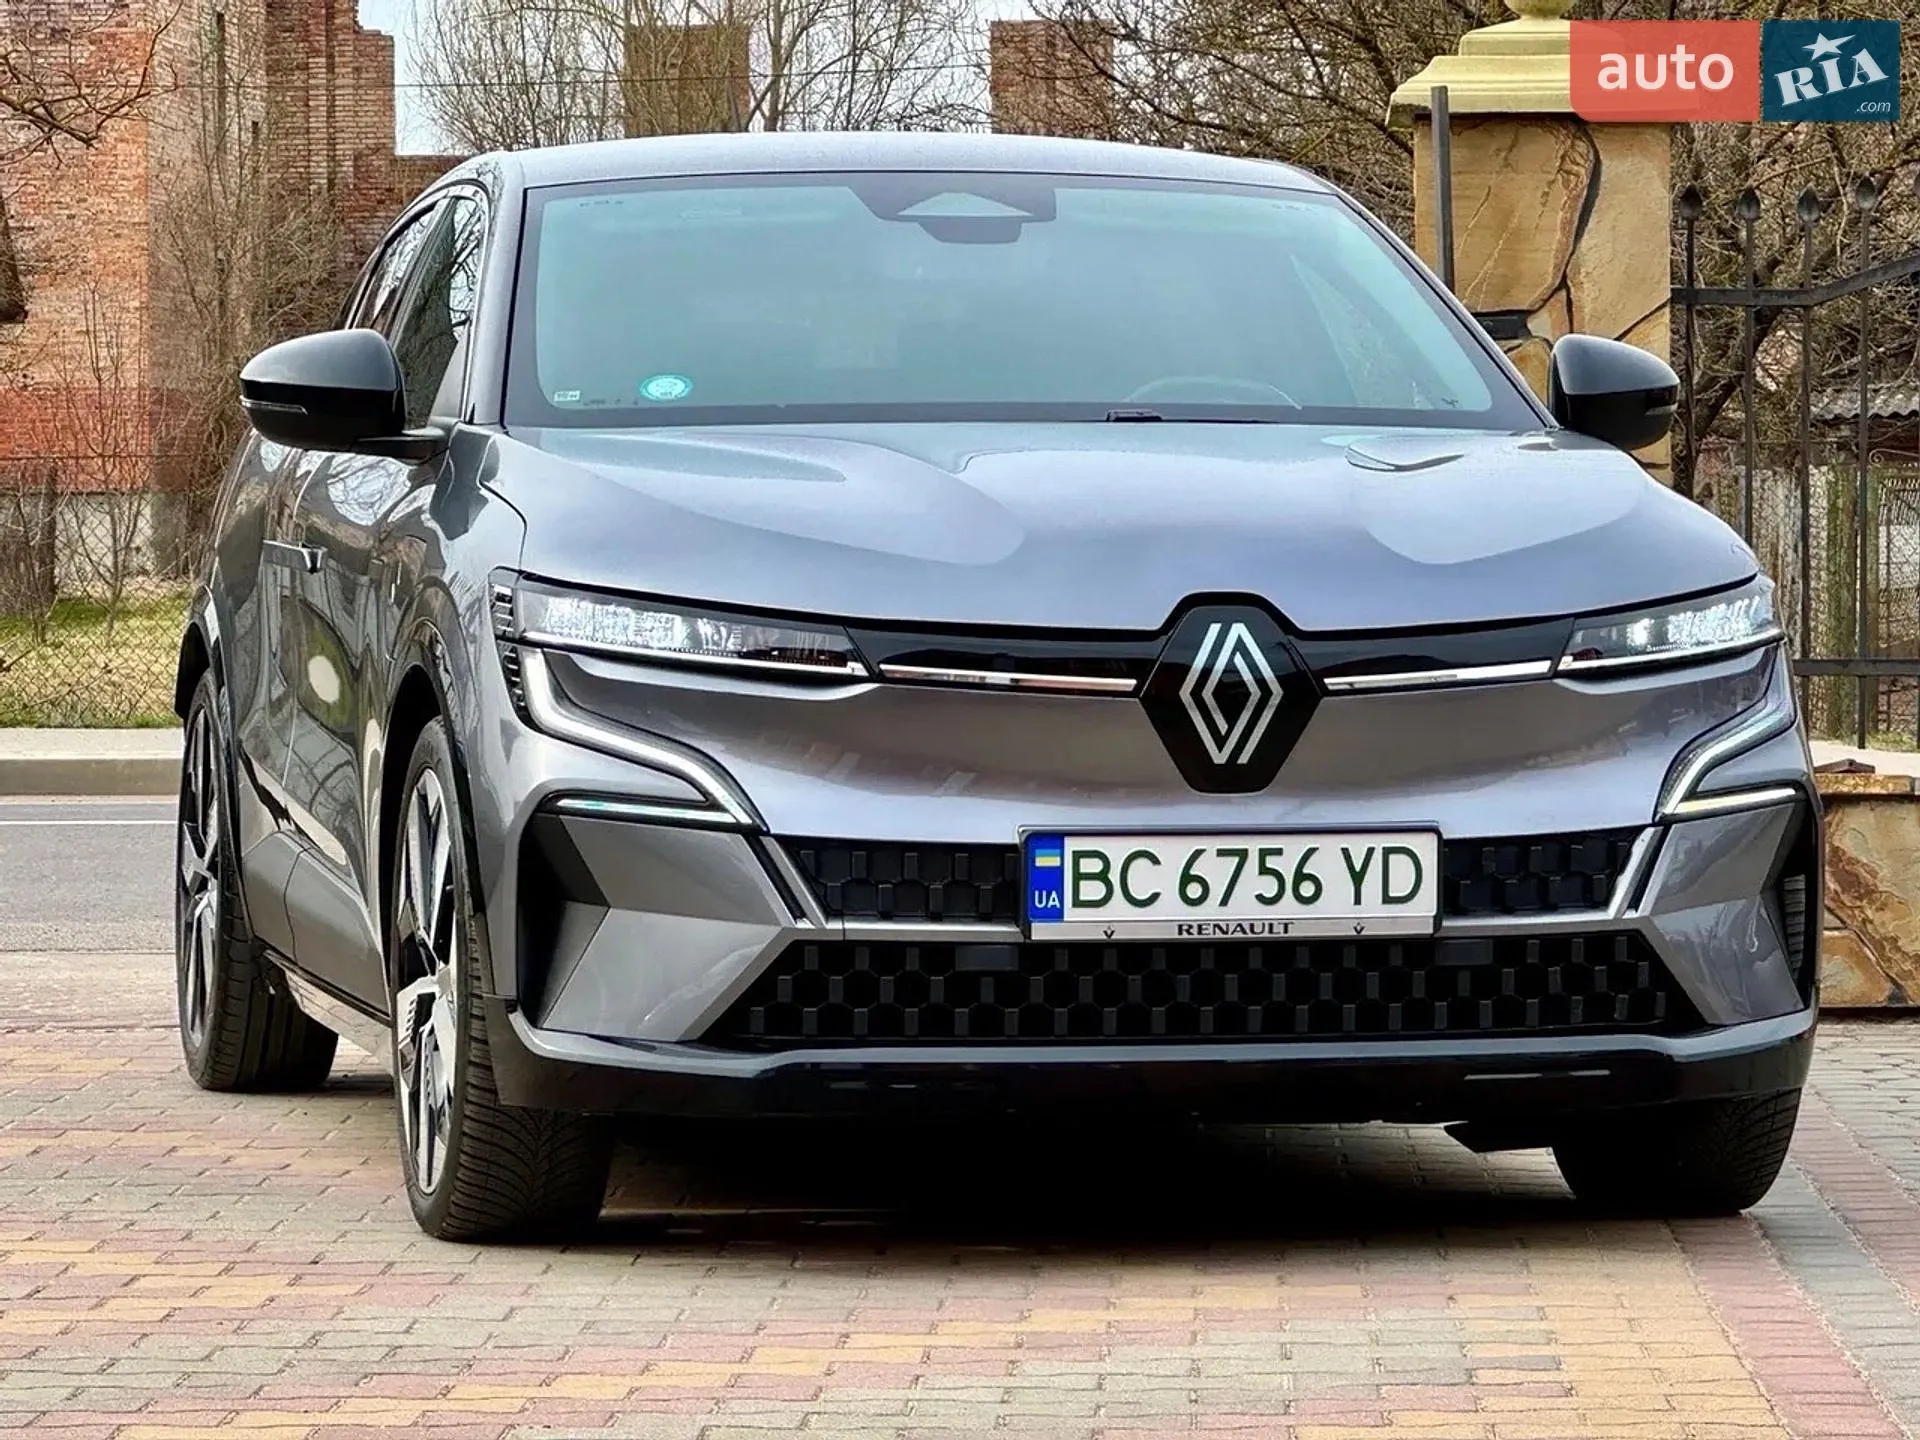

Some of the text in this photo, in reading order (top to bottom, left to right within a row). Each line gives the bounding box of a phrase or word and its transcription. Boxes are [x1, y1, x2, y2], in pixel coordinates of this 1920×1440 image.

[1070, 845, 1424, 909] BC 6756 YD
[1034, 890, 1061, 909] UA
[1177, 922, 1295, 937] RENAULT
